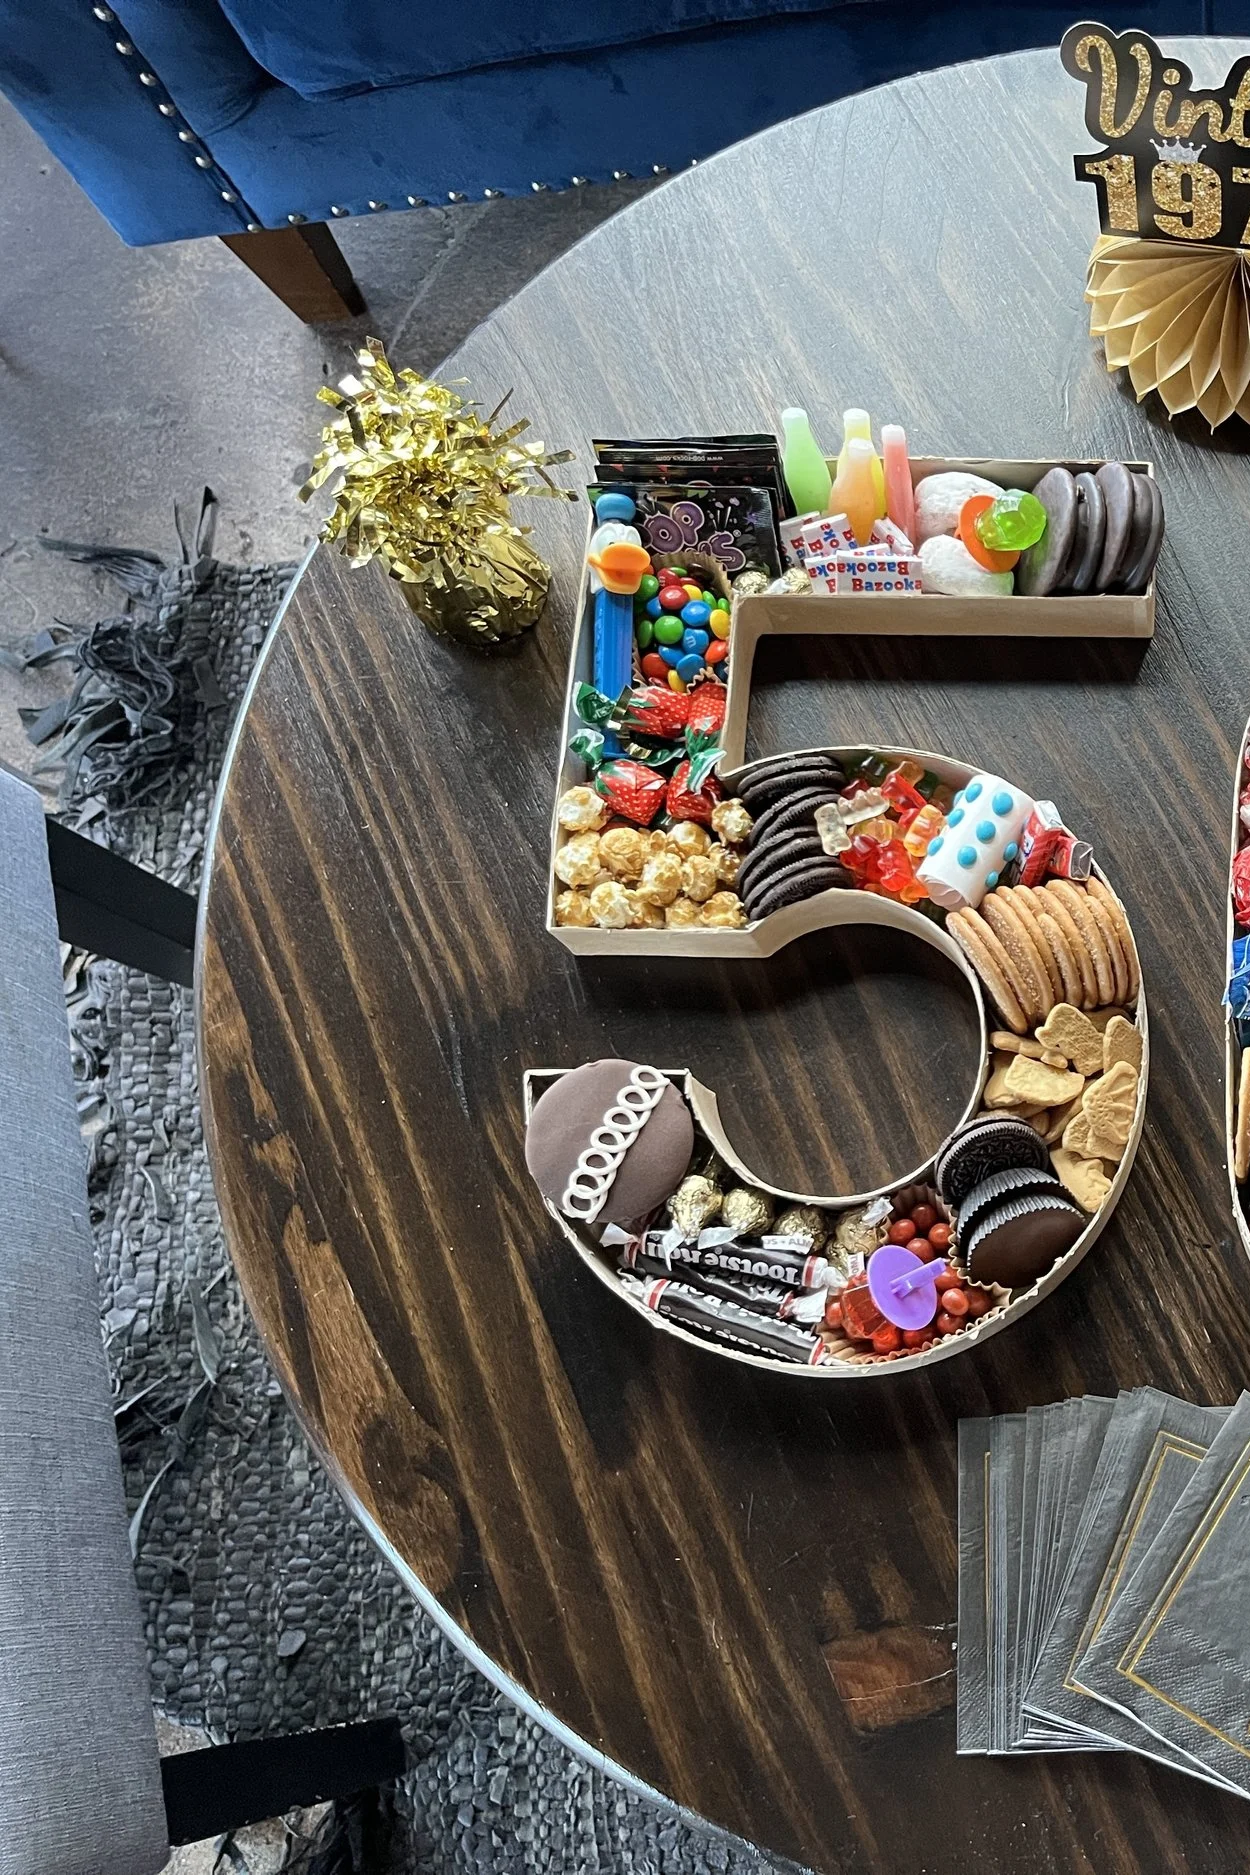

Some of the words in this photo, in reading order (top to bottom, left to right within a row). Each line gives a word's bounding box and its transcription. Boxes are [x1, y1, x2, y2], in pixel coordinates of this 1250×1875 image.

[836, 561, 910, 576] Bazooka
[852, 578, 922, 592] Bazooka
[704, 1252, 801, 1286] Tootsie
